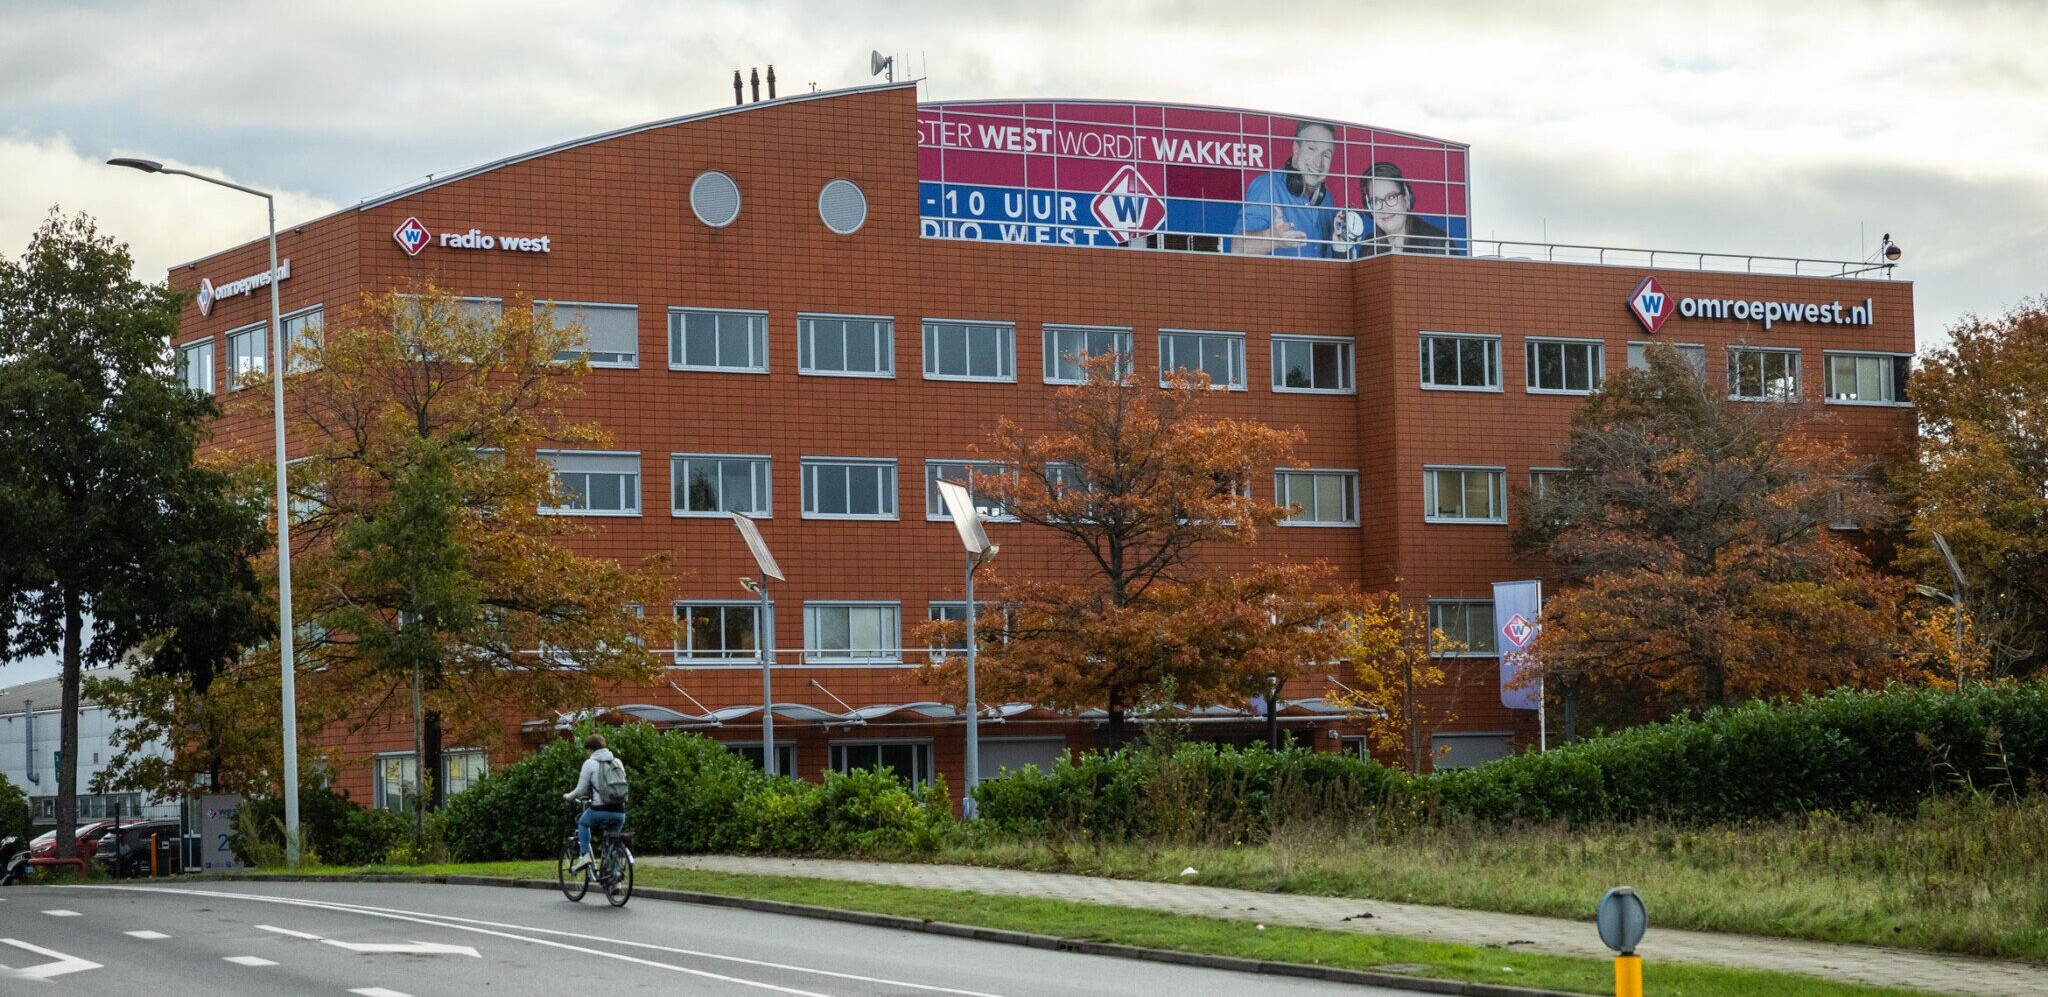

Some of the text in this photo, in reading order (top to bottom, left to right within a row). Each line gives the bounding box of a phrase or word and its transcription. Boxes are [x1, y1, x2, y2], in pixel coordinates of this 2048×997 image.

[978, 124, 1053, 152] WEST
[1058, 130, 1147, 159] WORDT
[1151, 136, 1264, 168] WAKKER
[1004, 193, 1077, 222] UUR
[404, 230, 420, 243] W
[440, 228, 550, 252] radio west
[1641, 294, 1662, 314] W
[1679, 297, 1873, 330] omroepwest.nl
